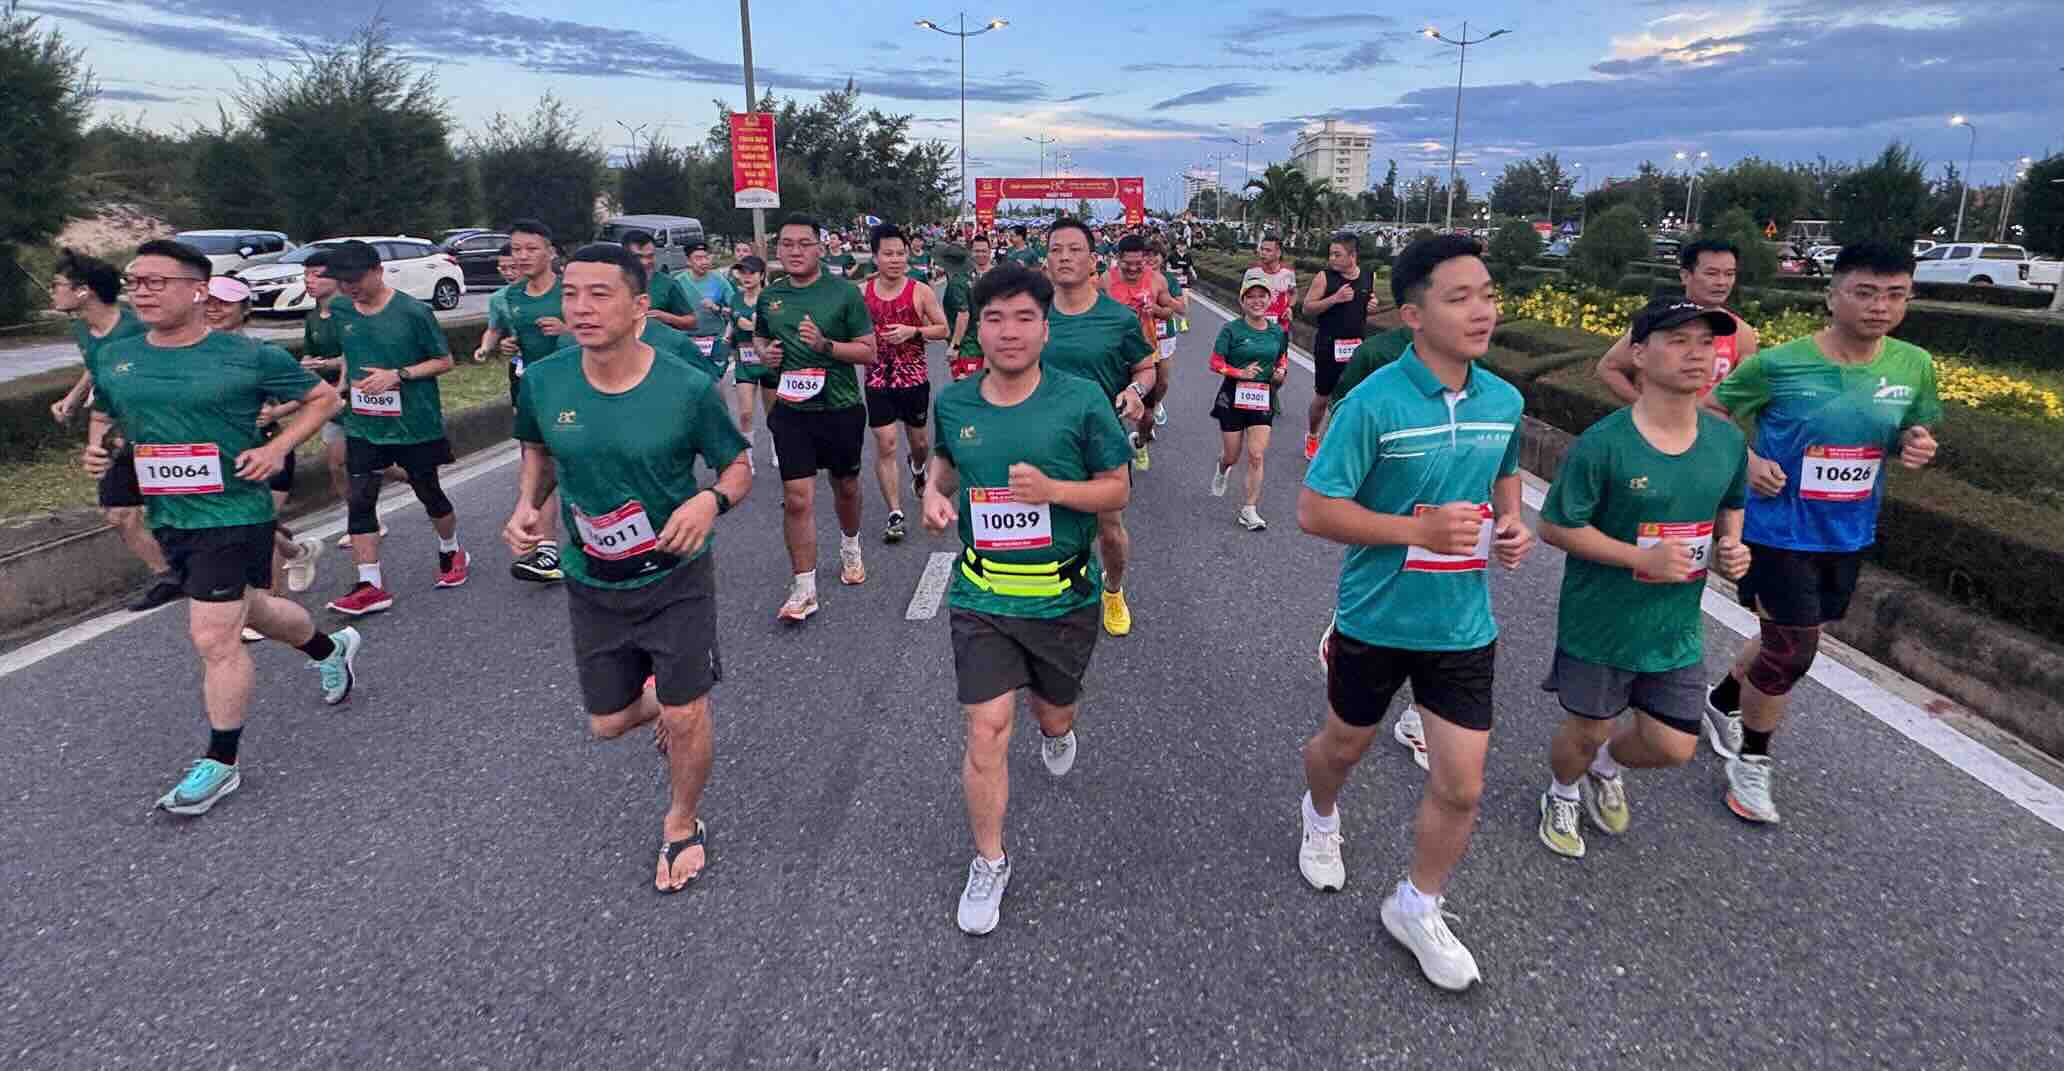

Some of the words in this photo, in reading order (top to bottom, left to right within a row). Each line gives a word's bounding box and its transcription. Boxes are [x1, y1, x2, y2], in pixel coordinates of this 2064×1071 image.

[787, 380, 818, 390] 10636
[357, 394, 394, 405] 10089
[147, 464, 210, 479] 10064
[1816, 466, 1871, 481] 10626
[982, 511, 1040, 529] 10039
